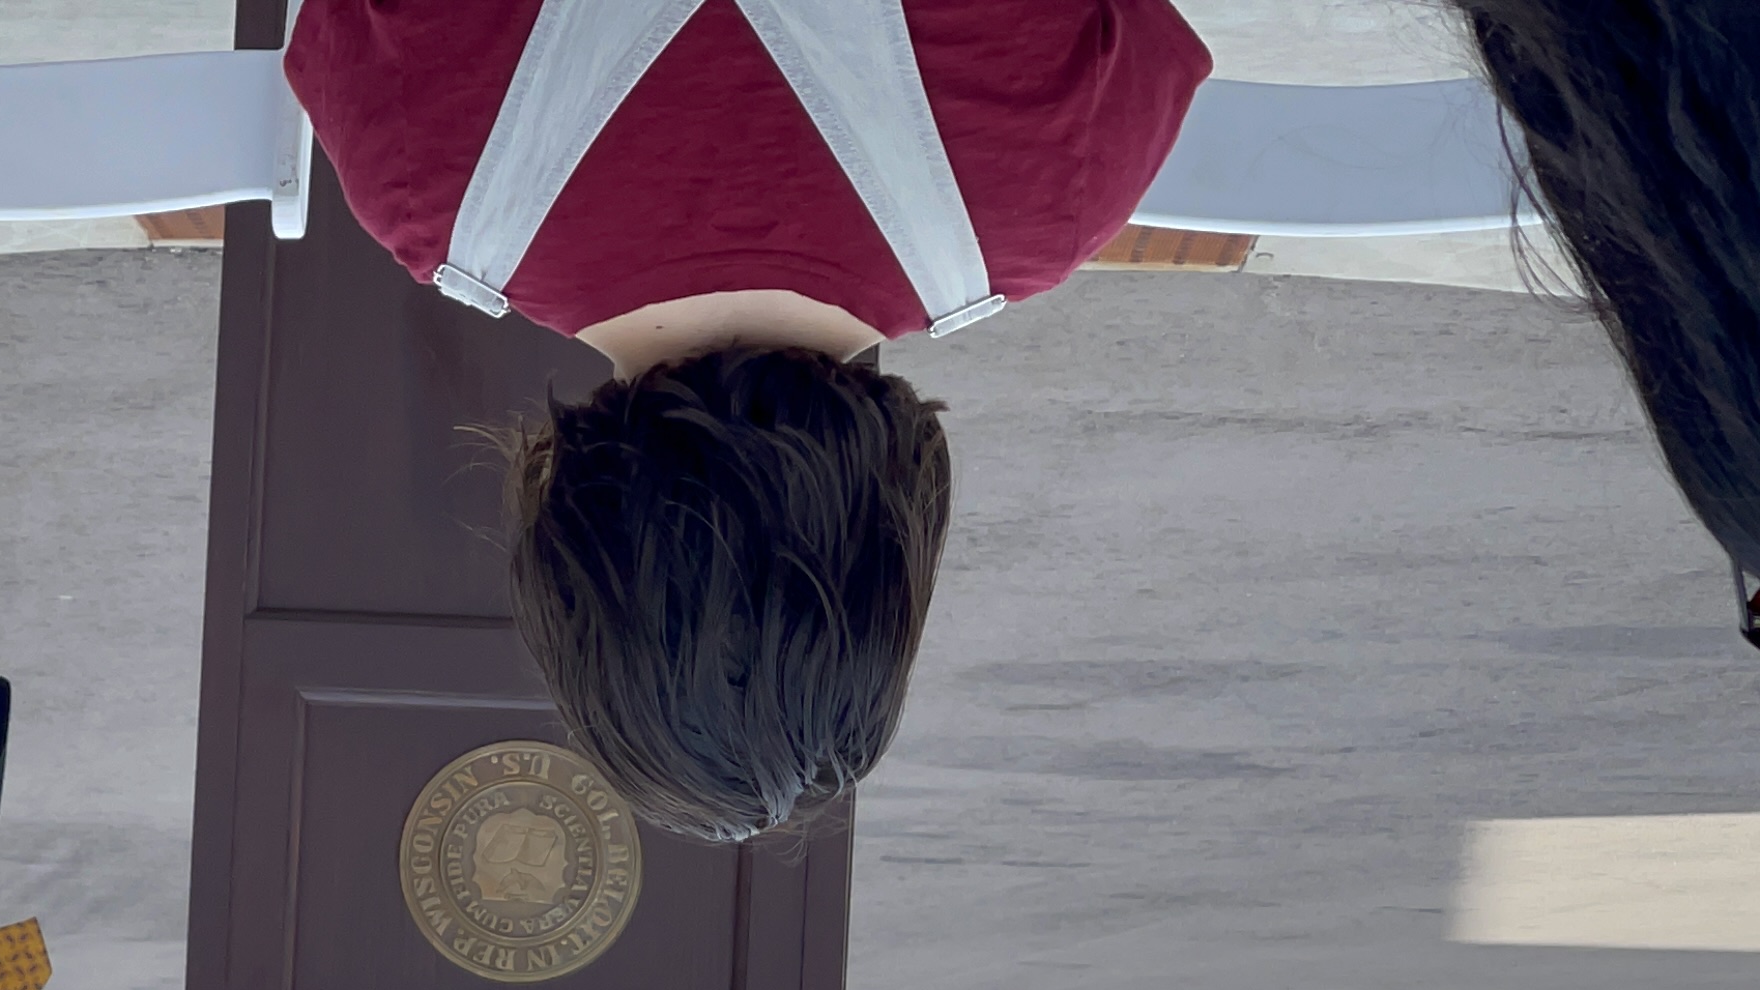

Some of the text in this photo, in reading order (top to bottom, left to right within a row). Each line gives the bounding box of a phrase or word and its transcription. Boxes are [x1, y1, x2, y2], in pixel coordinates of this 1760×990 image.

[491, 753, 550, 780] U.S.
[410, 765, 479, 936] WISCONSIN
[446, 791, 593, 934] SCIENTIA VERA CUM FIDE PURA
[453, 929, 515, 971] REP.
[527, 943, 559, 971] IN
